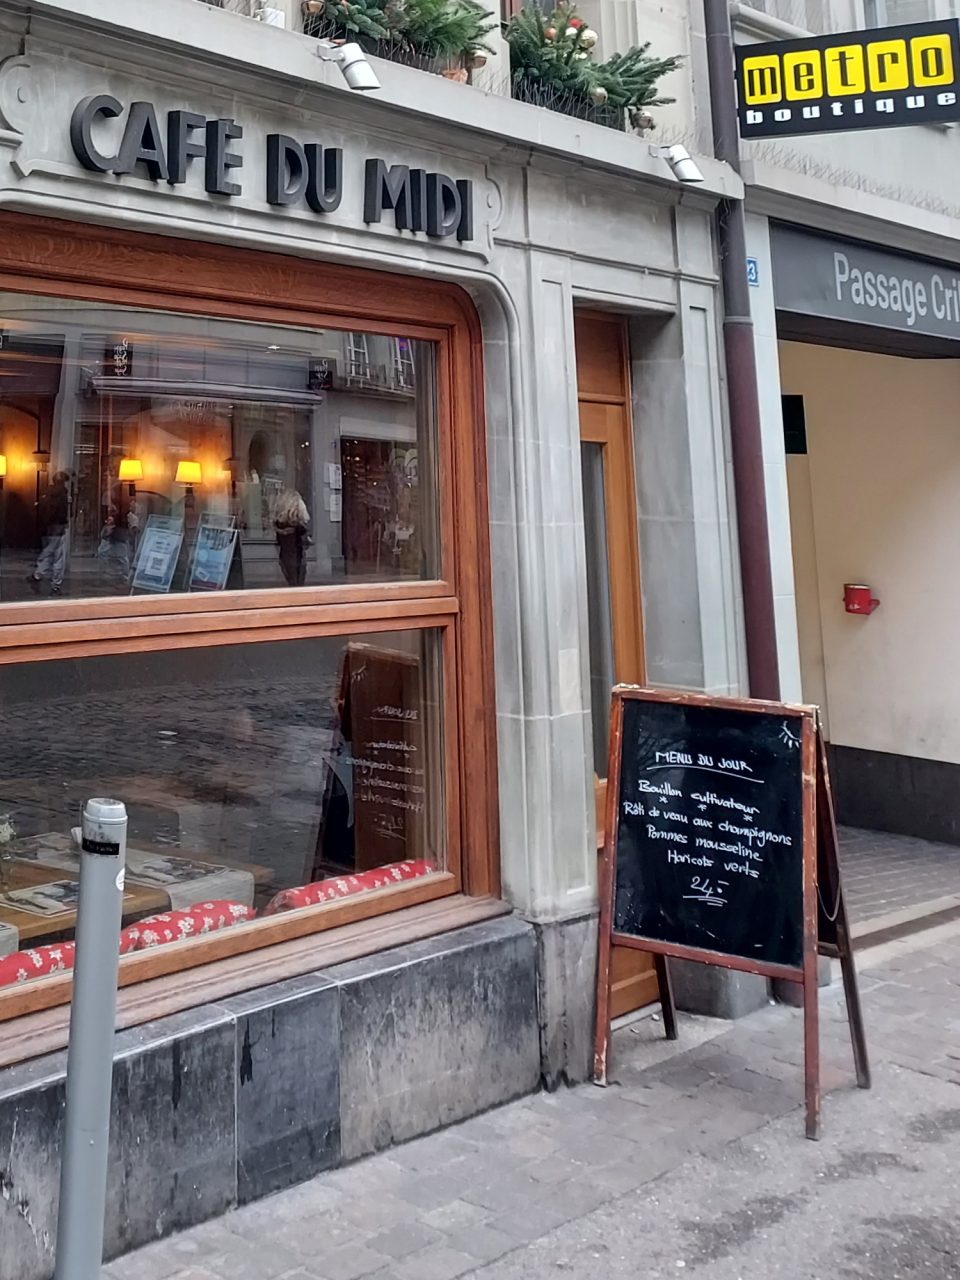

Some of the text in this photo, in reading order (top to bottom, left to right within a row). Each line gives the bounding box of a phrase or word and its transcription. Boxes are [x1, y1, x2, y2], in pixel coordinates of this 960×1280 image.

[746, 46, 946, 98] metro
[746, 92, 957, 125] boutique
[266, 133, 343, 214] DU
[363, 157, 474, 242] MIDI
[833, 252, 960, 326] Passage Cri
[655, 751, 753, 773] MENU DU JOUR
[638, 779, 761, 814] Bouillon cultivateur
[645, 824, 764, 862] Pommes mousseline
[648, 806, 660, 818] de
[663, 811, 689, 824] veau
[693, 818, 713, 829] aux
[718, 820, 792, 848] champignons
[667, 849, 760, 878] Haricots verts
